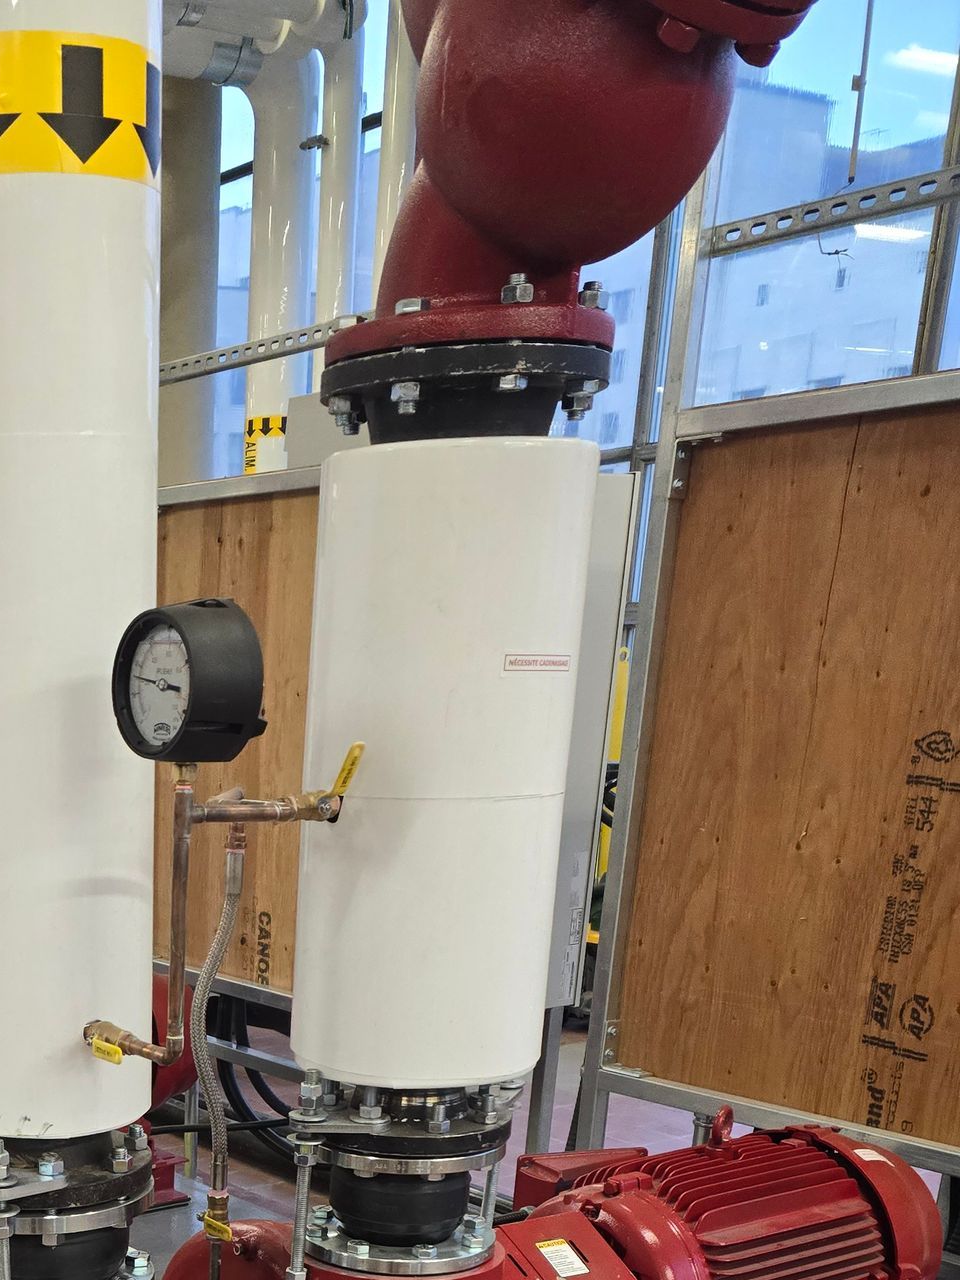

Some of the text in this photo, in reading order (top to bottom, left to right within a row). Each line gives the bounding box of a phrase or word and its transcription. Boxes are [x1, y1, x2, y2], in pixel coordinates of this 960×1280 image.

[244, 441, 257, 472] ALIM.
[915, 796, 939, 833] 544
[872, 982, 891, 1029] APA
[909, 994, 929, 1041] APA
